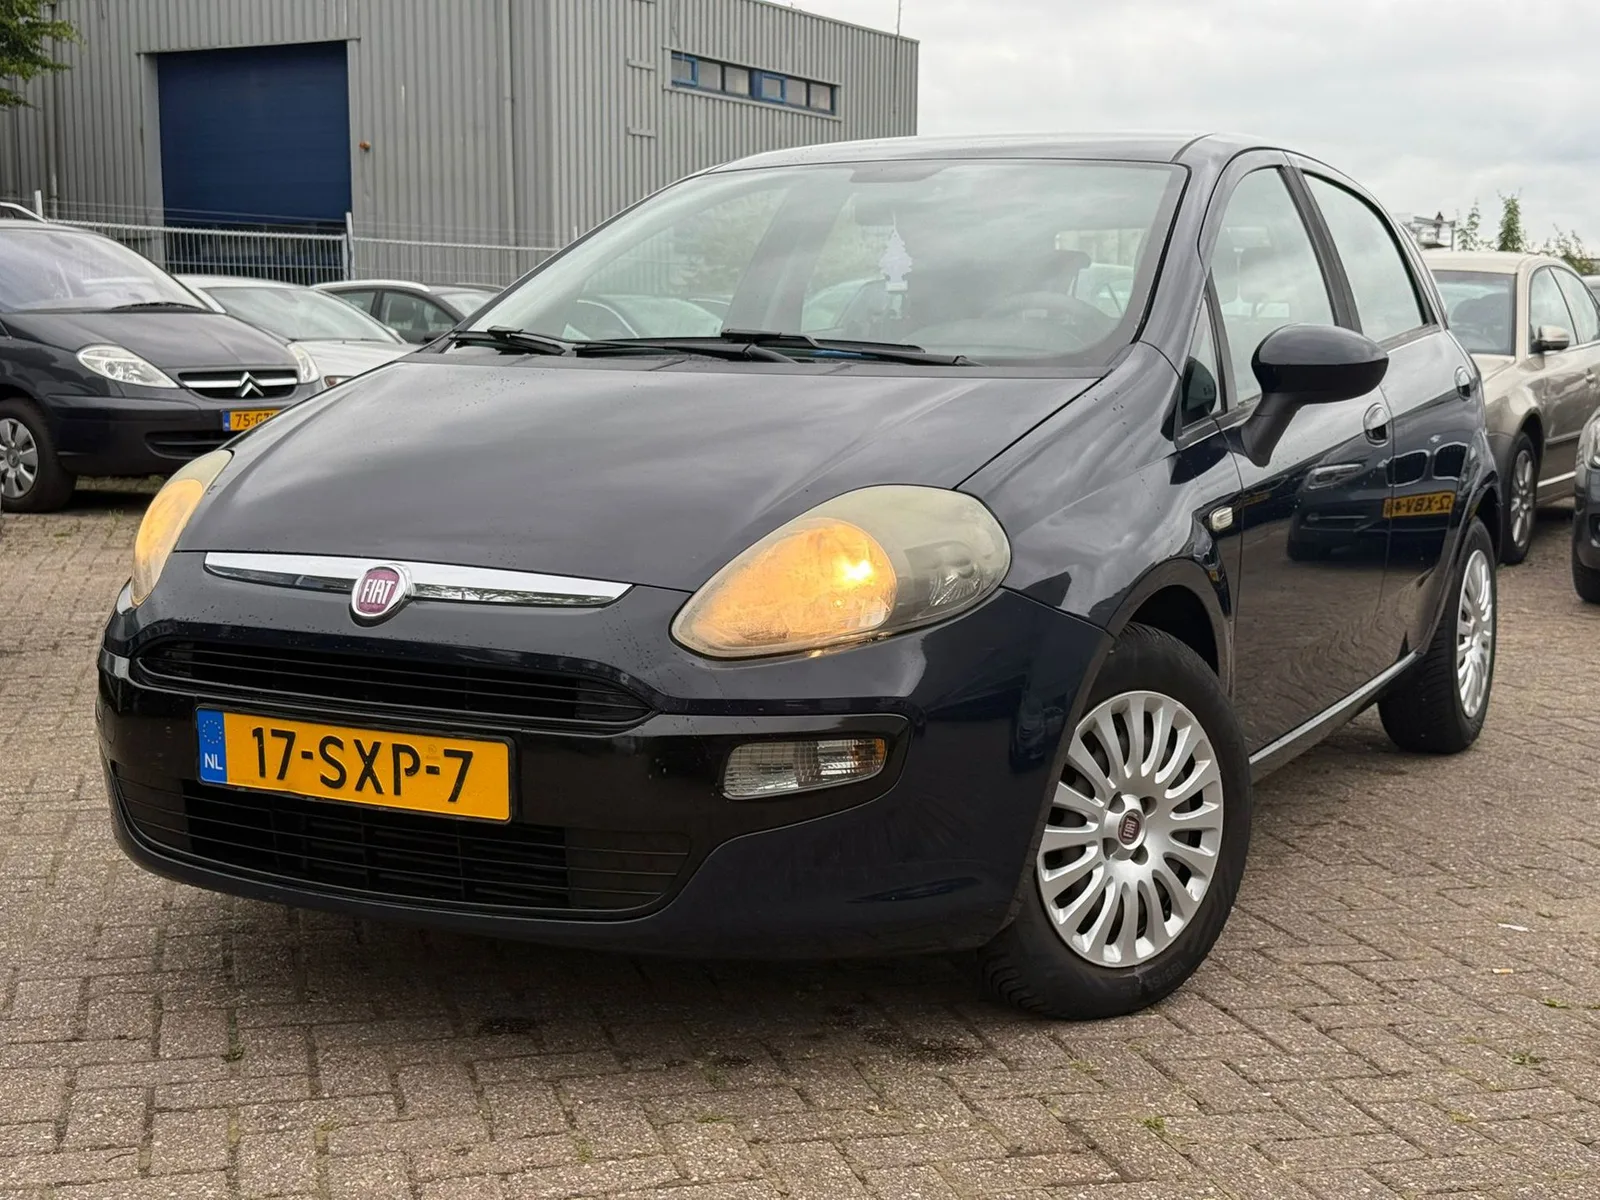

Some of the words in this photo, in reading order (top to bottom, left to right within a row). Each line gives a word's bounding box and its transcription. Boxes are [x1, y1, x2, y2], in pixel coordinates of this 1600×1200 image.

[360, 579, 395, 604] FIAT
[204, 752, 223, 771] NL
[251, 726, 474, 803] 17-SXP-7
[1122, 818, 1137, 839] FIAT
